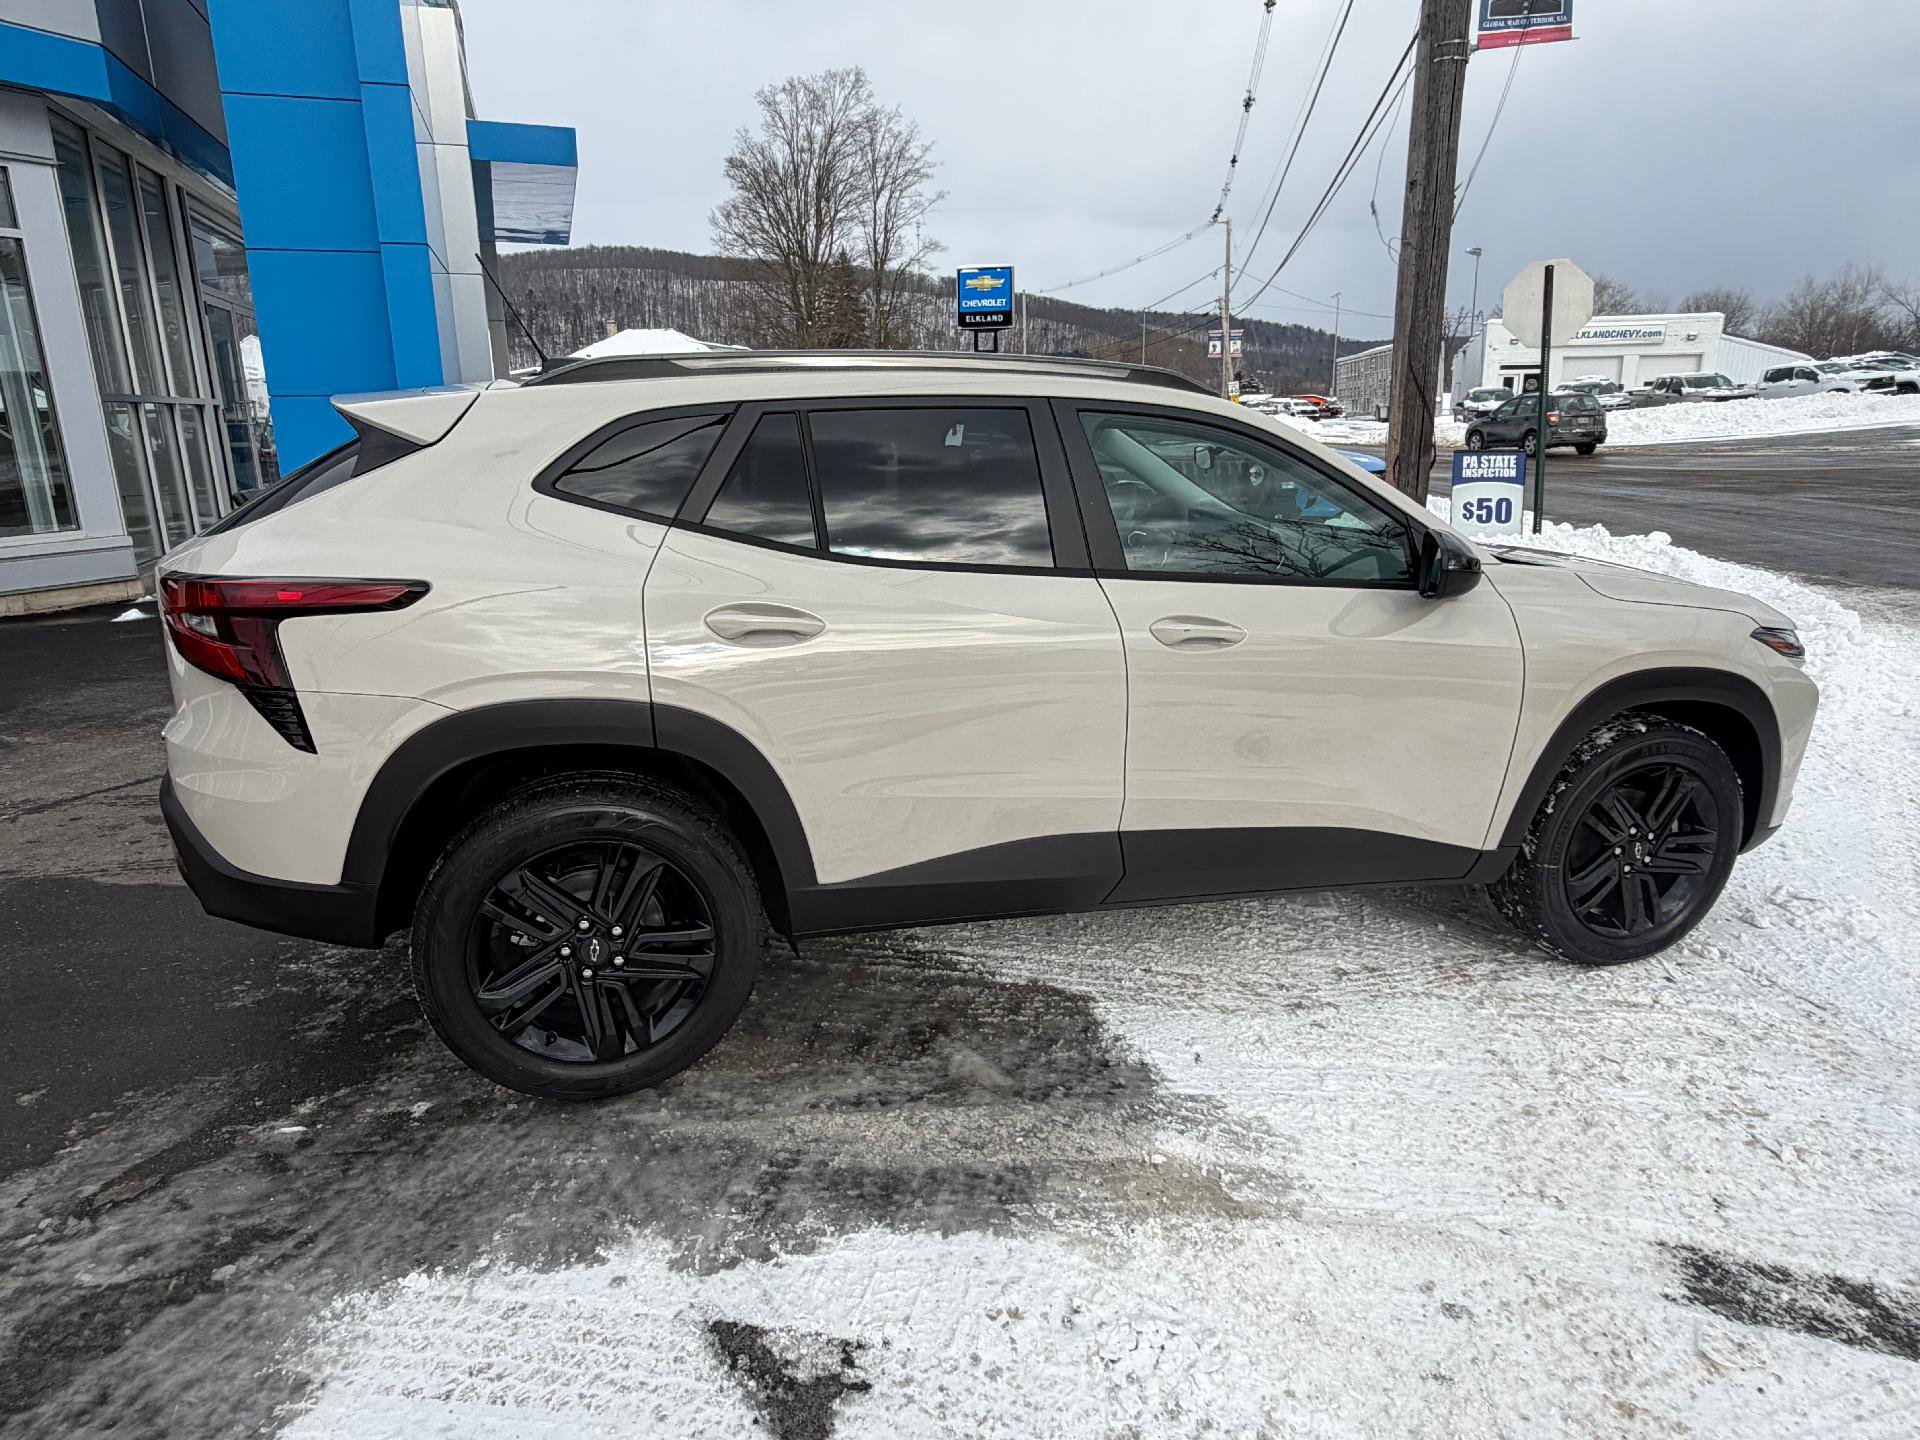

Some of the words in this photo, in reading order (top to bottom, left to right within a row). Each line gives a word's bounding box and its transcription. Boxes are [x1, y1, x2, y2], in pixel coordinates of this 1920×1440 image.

[1482, 20, 1506, 28] GLOBAL
[1506, 18, 1521, 26] WAR
[962, 298, 1007, 308] CHEVROLET
[965, 314, 1004, 323] ELKLAND
[1569, 329, 1663, 339] LKLANDCHEVY.com
[1462, 455, 1479, 469] PA
[1480, 455, 1518, 468] STATE
[1462, 467, 1517, 478] INSPECTION
[1461, 497, 1513, 525] $50
